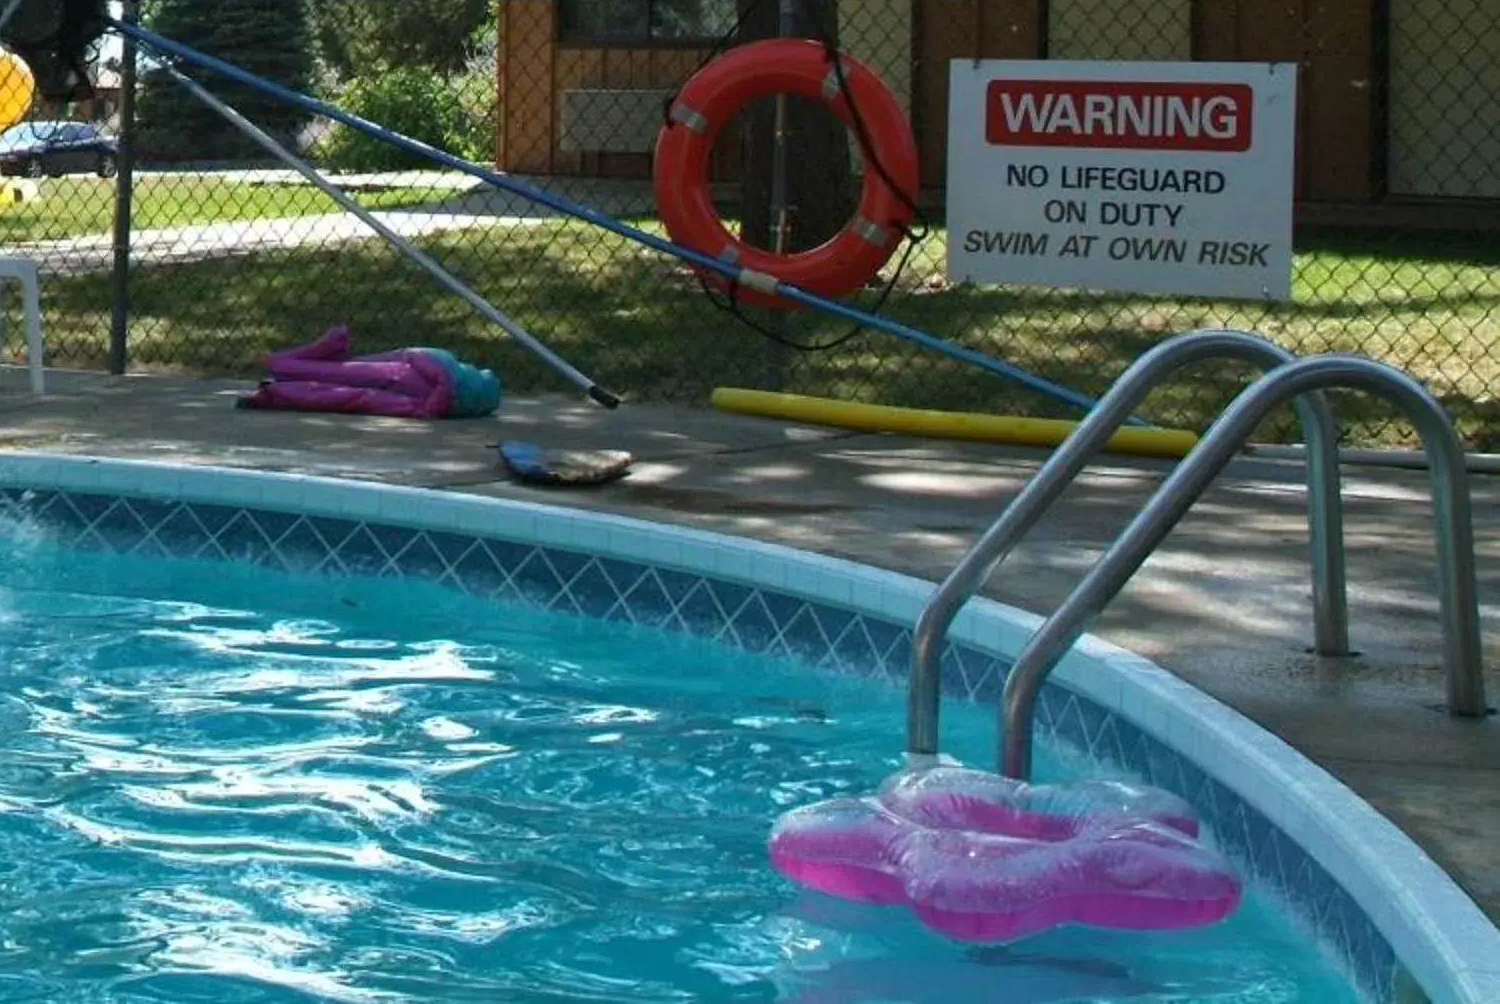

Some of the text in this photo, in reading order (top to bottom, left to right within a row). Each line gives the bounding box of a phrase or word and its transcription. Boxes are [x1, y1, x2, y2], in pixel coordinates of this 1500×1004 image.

[1000, 92, 1239, 139] WARNING
[1007, 164, 1226, 195] NO LIFEGUARD
[1044, 199, 1185, 228] ON DUTY
[964, 229, 1272, 268] SWIM AT OWN RISK
